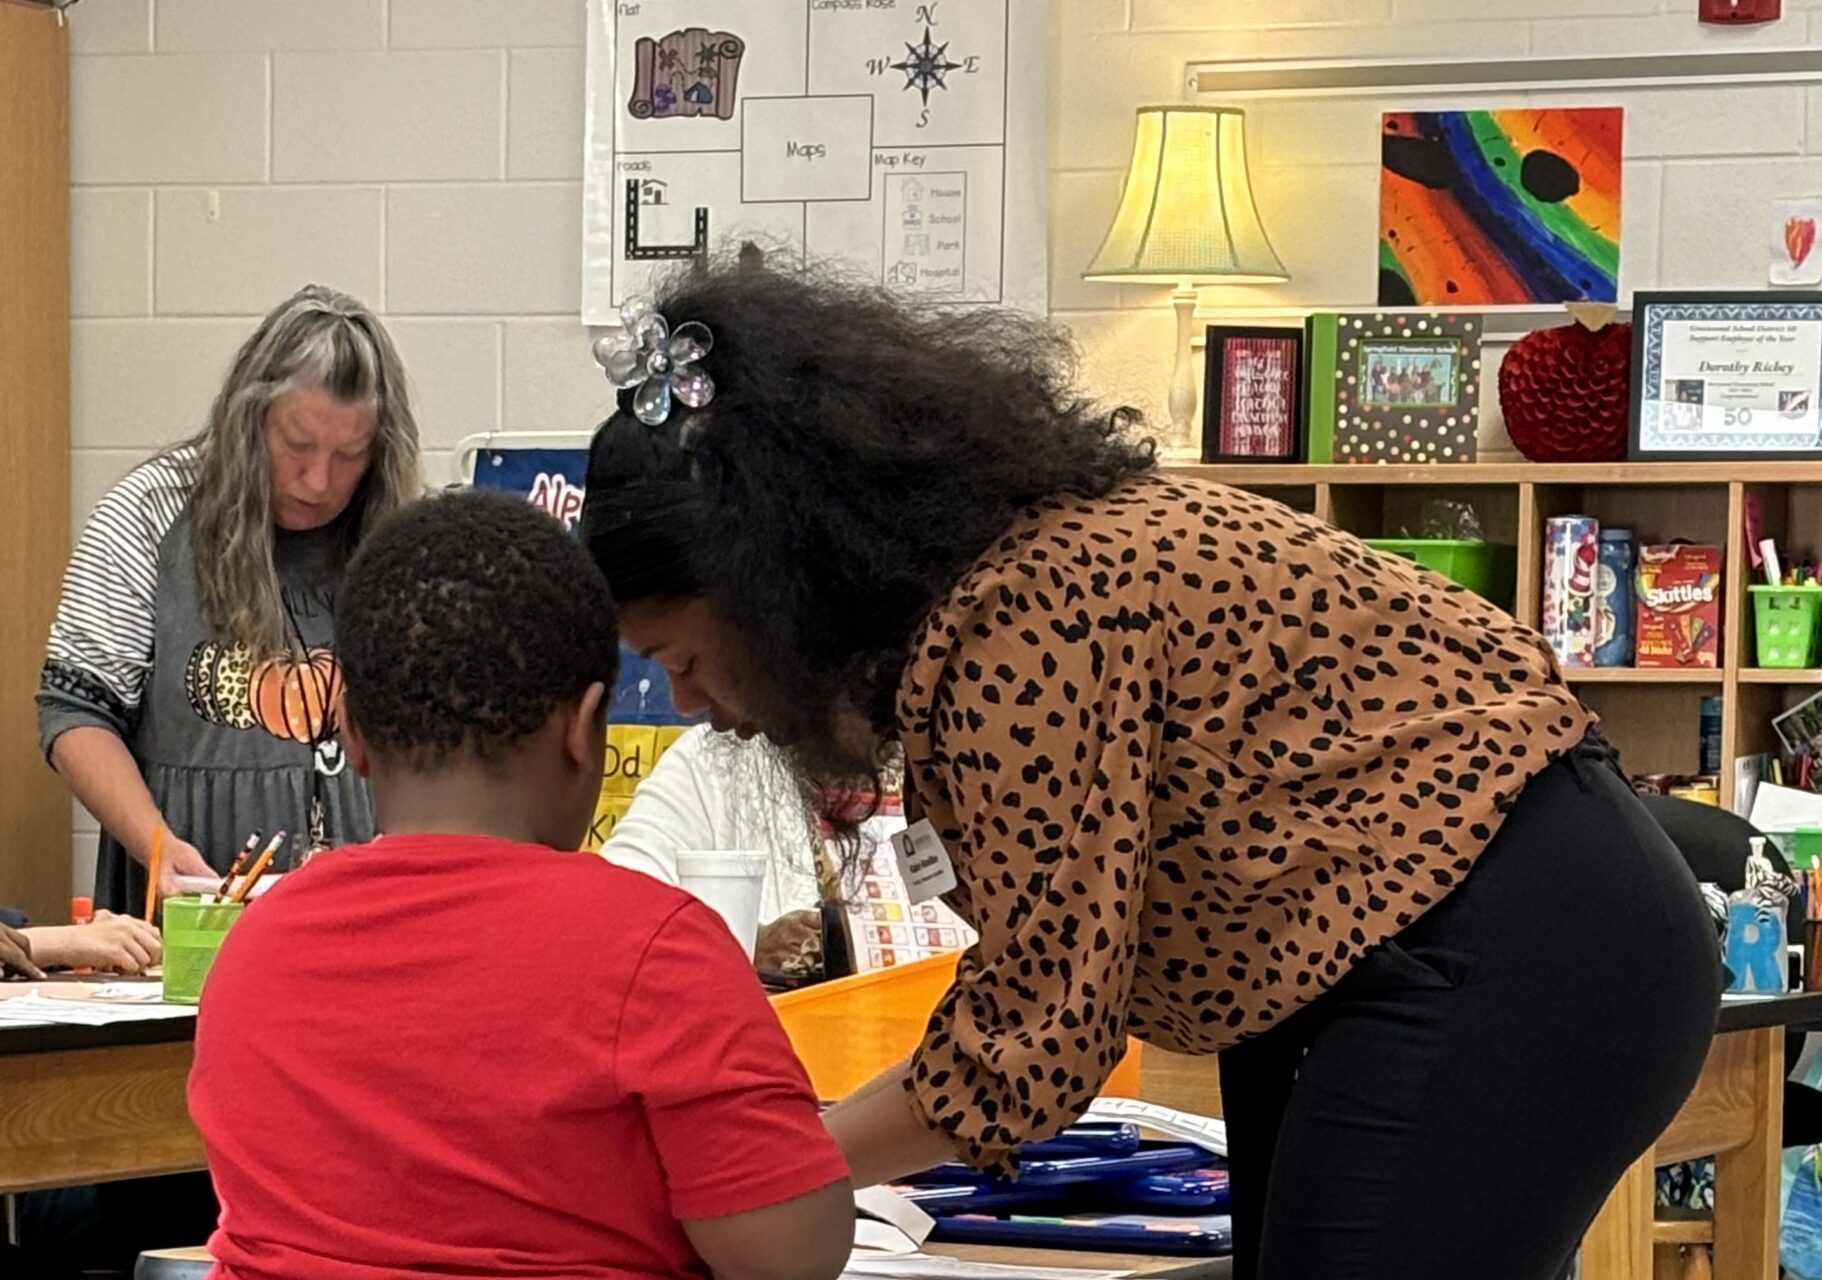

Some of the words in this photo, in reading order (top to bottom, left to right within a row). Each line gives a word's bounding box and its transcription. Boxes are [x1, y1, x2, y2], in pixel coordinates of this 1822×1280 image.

[915, 2, 938, 26] N
[866, 56, 891, 76] W
[963, 56, 980, 73] E
[915, 109, 930, 128] S
[786, 142, 826, 161] Maps
[875, 153, 899, 168] Map
[903, 152, 926, 168] Key
[930, 188, 961, 198] House
[928, 214, 961, 224] School
[1698, 360, 1750, 376] Dorothy
[1723, 406, 1752, 427] 50
[1645, 584, 1713, 607] Skittles
[603, 744, 641, 778] Dd
[588, 813, 617, 847] K
